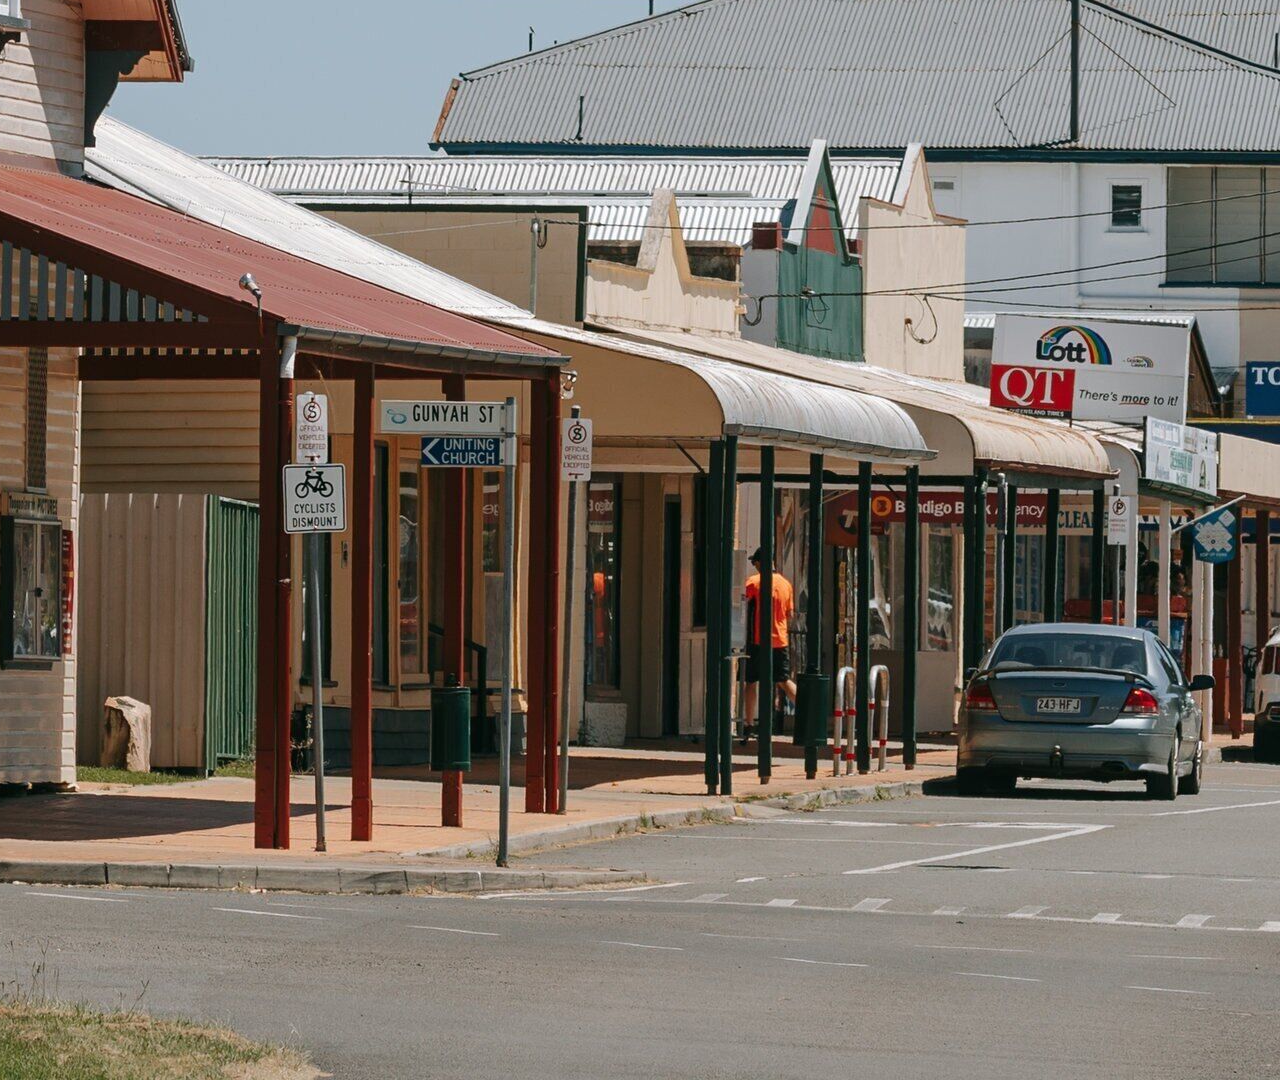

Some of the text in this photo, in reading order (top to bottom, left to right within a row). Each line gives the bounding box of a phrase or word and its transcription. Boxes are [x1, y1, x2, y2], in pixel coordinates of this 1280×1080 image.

[1036, 339, 1087, 363] Lott
[999, 367, 1064, 406] QT
[1079, 389, 1179, 406] There's more to it!
[412, 404, 495, 423] GUNYAH ST
[443, 438, 495, 451] UNITING
[441, 452, 495, 464] CHURCH
[294, 502, 336, 514] CYCLISTS
[894, 500, 952, 517] Bdigo
[292, 517, 338, 528] DISMOUNT
